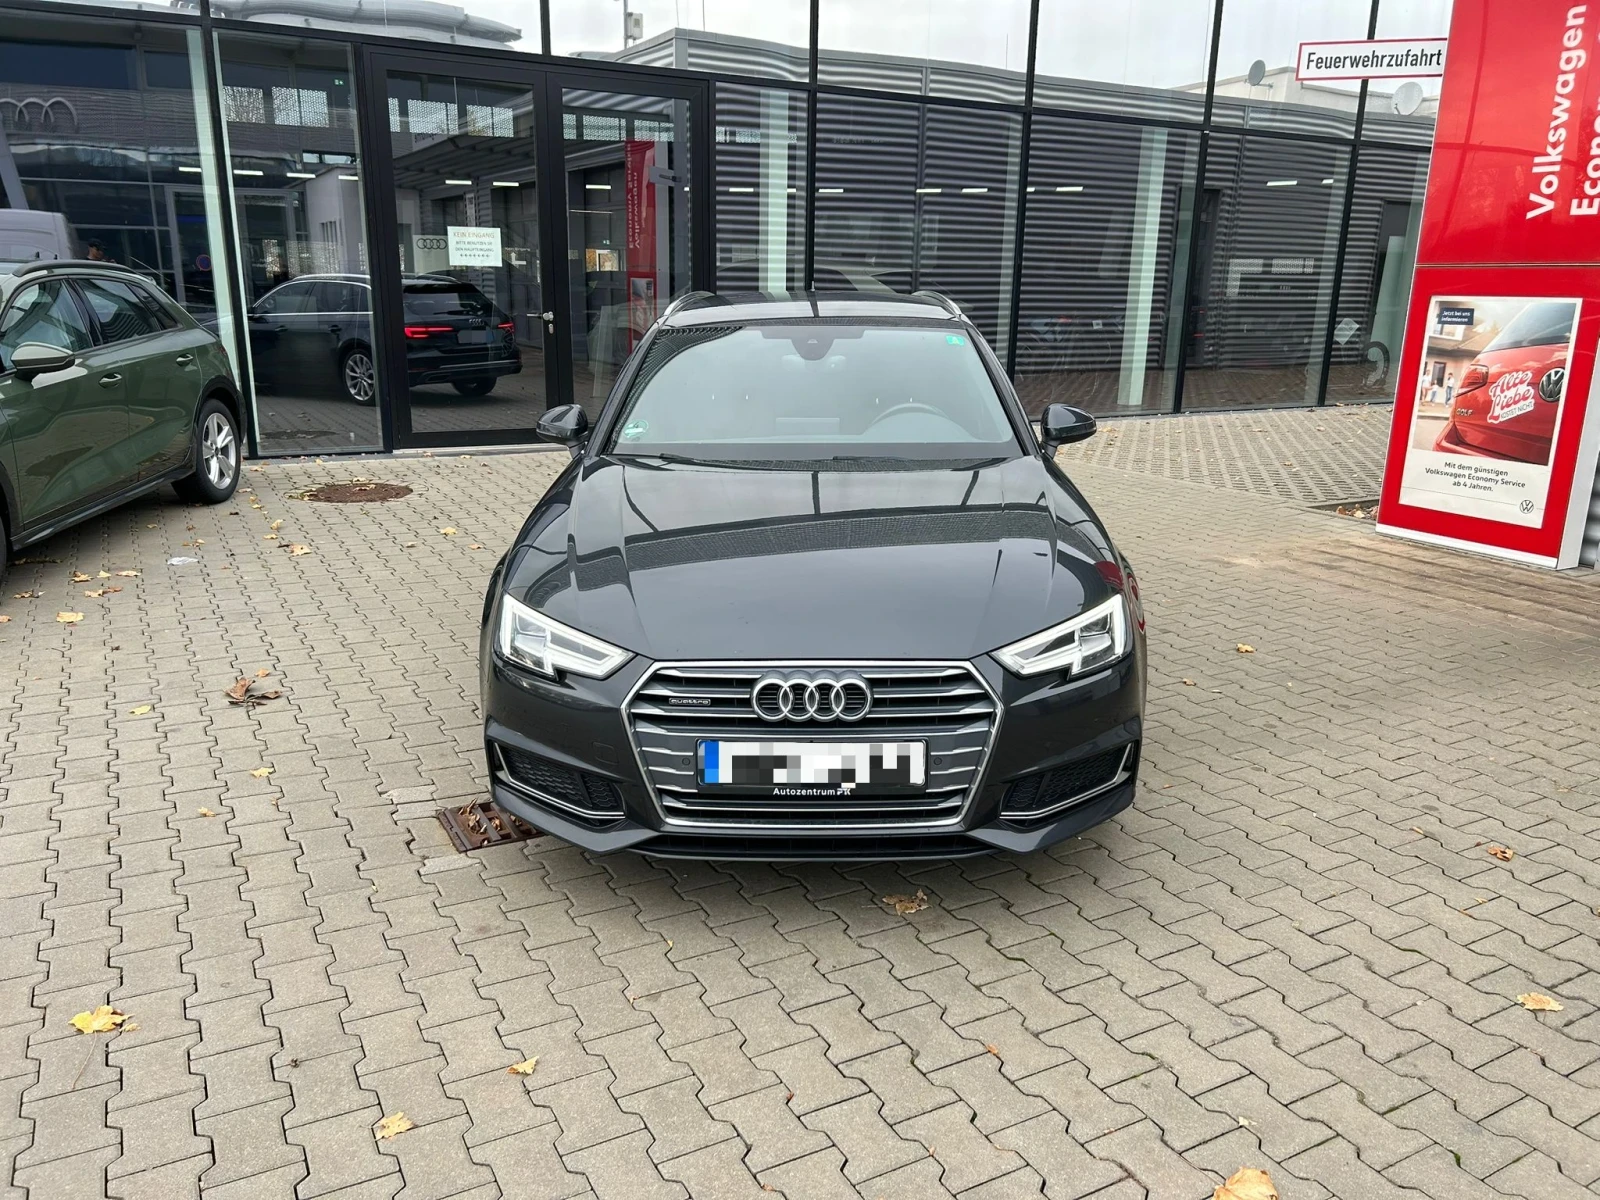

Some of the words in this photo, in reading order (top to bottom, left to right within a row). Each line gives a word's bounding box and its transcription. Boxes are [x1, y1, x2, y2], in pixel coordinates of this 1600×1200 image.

[1307, 48, 1442, 70] Feuerwehrzufahrt
[1526, 4, 1587, 219] Volkswagen
[1490, 371, 1531, 397] Alte
[1488, 387, 1532, 420] Liebe
[1425, 467, 1466, 479] Volkswagen
[1468, 473, 1499, 485] Economy
[1501, 478, 1526, 489] Service
[1457, 463, 1473, 471] dem
[1474, 466, 1508, 477] günstigen
[1468, 482, 1494, 492] Jahren.
